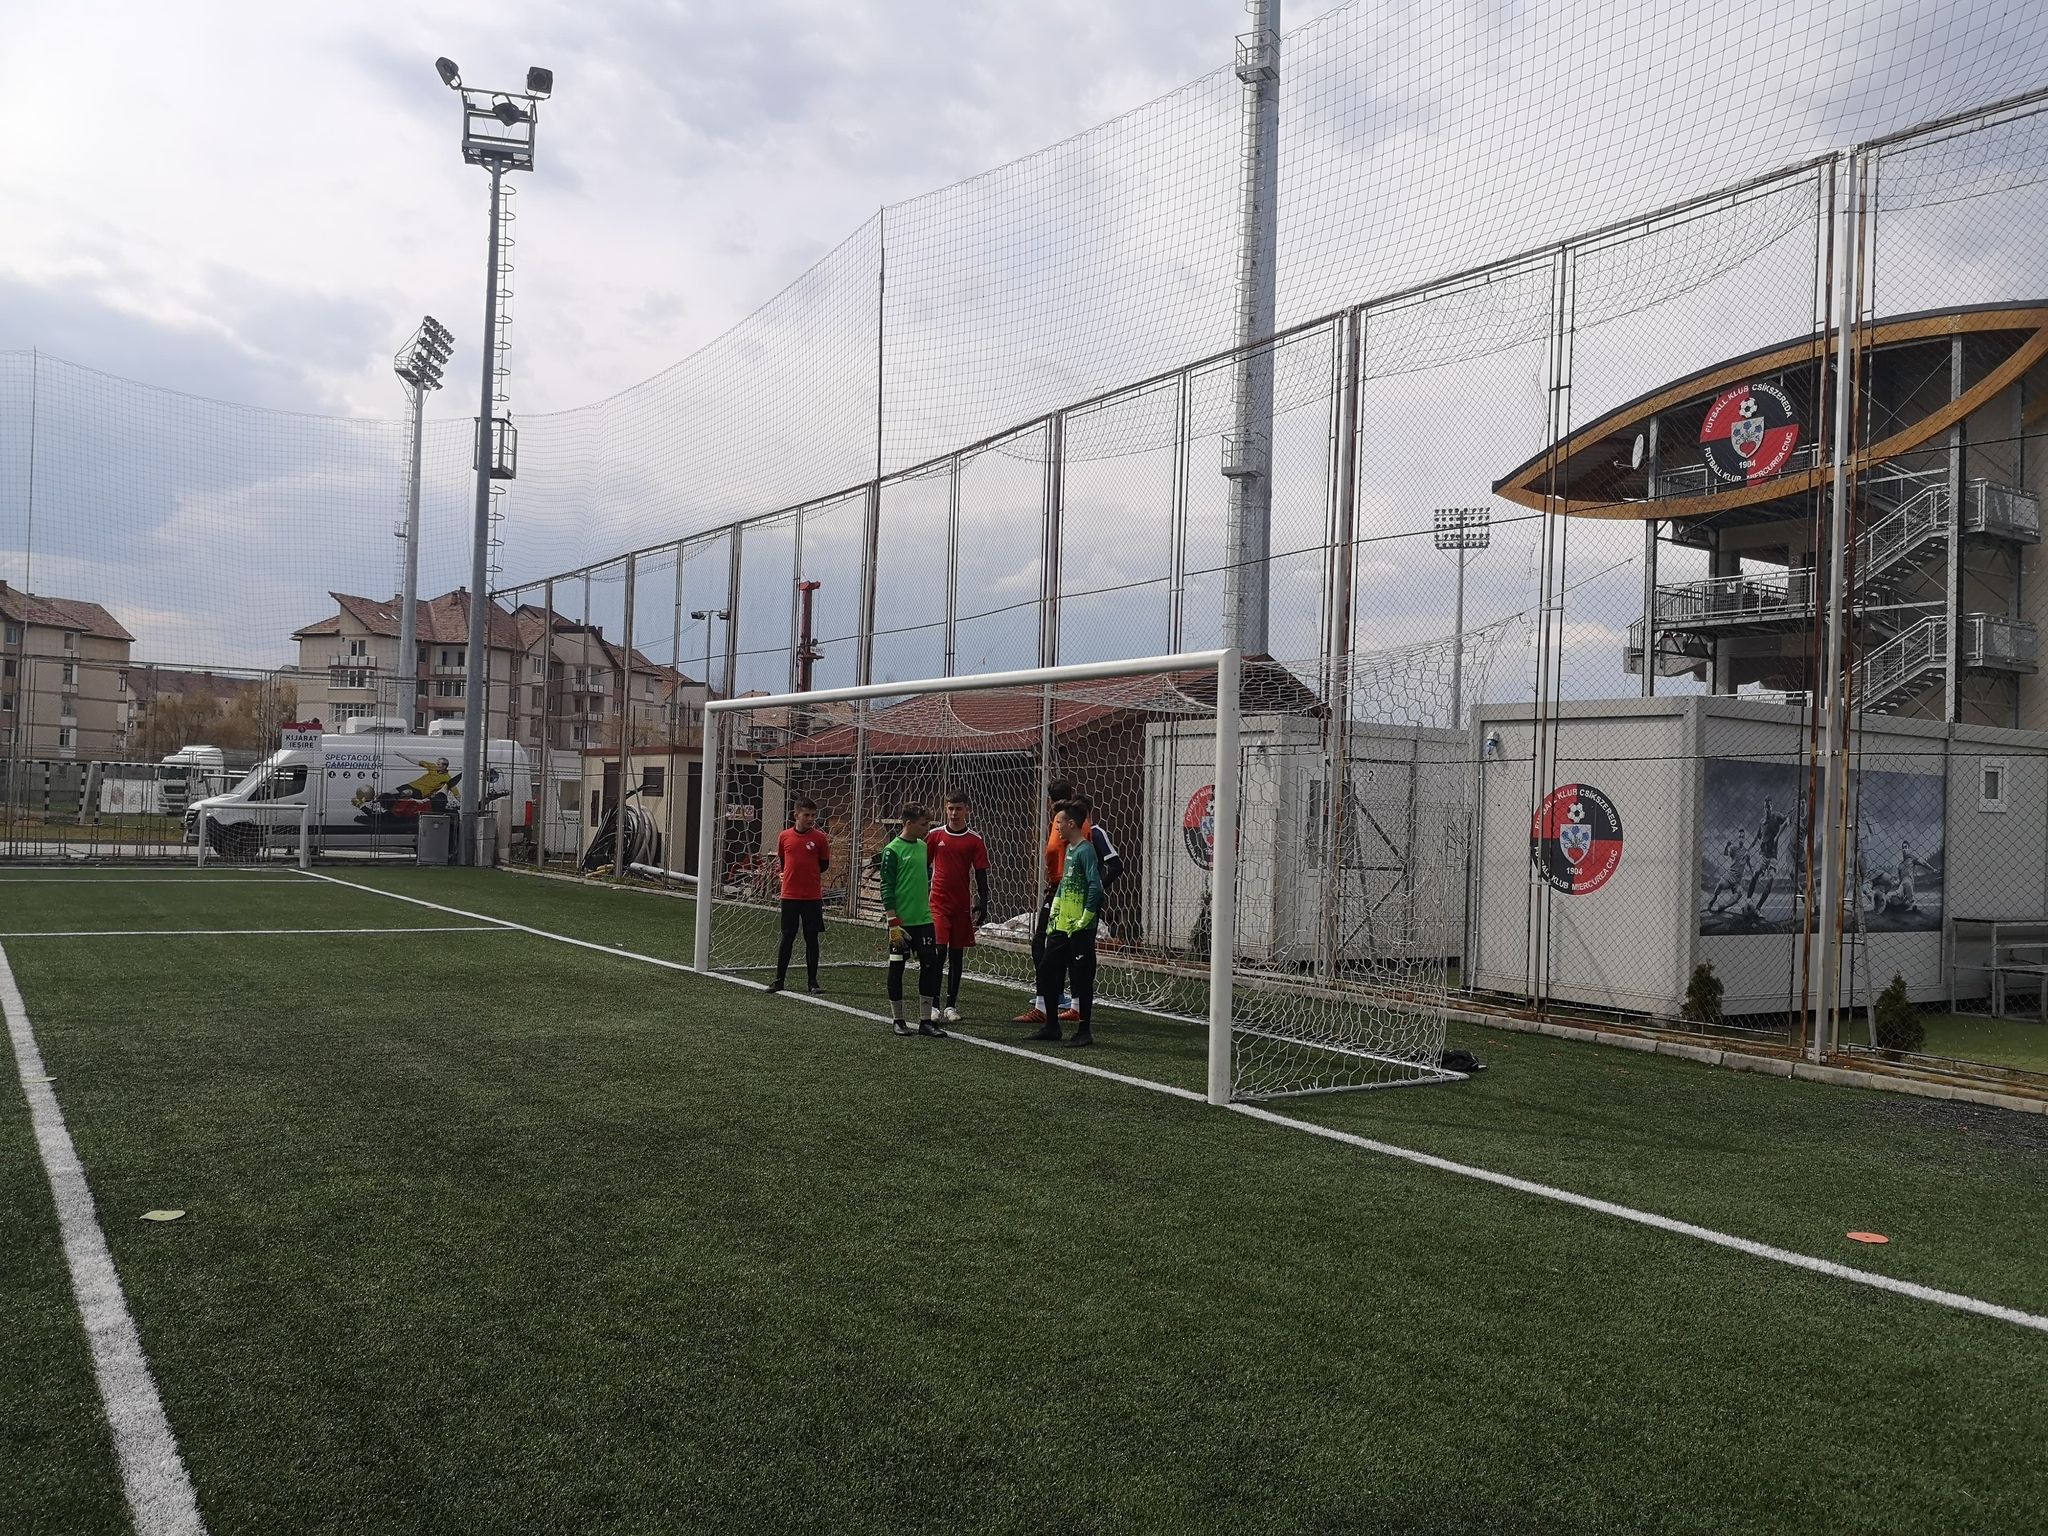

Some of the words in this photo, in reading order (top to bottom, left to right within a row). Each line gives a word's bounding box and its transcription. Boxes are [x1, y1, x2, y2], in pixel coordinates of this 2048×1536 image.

[1705, 399, 1728, 433] FUTBALL
[1728, 385, 1749, 400] KLUB
[1752, 383, 1793, 418] CSÍKSZEREDA
[1704, 447, 1723, 476] FUTBALL
[1781, 432, 1793, 452] CIUC
[1739, 460, 1756, 469] 1904
[1557, 788, 1578, 799] KLUB
[1579, 788, 1619, 833] CSÍKSZEREDA
[1551, 875, 1569, 889] KLUB
[1571, 868, 1610, 891] MIERCUREA
[1606, 849, 1618, 869] CIUC
[1566, 867, 1583, 875] 1904
[921, 936, 933, 945] 12
